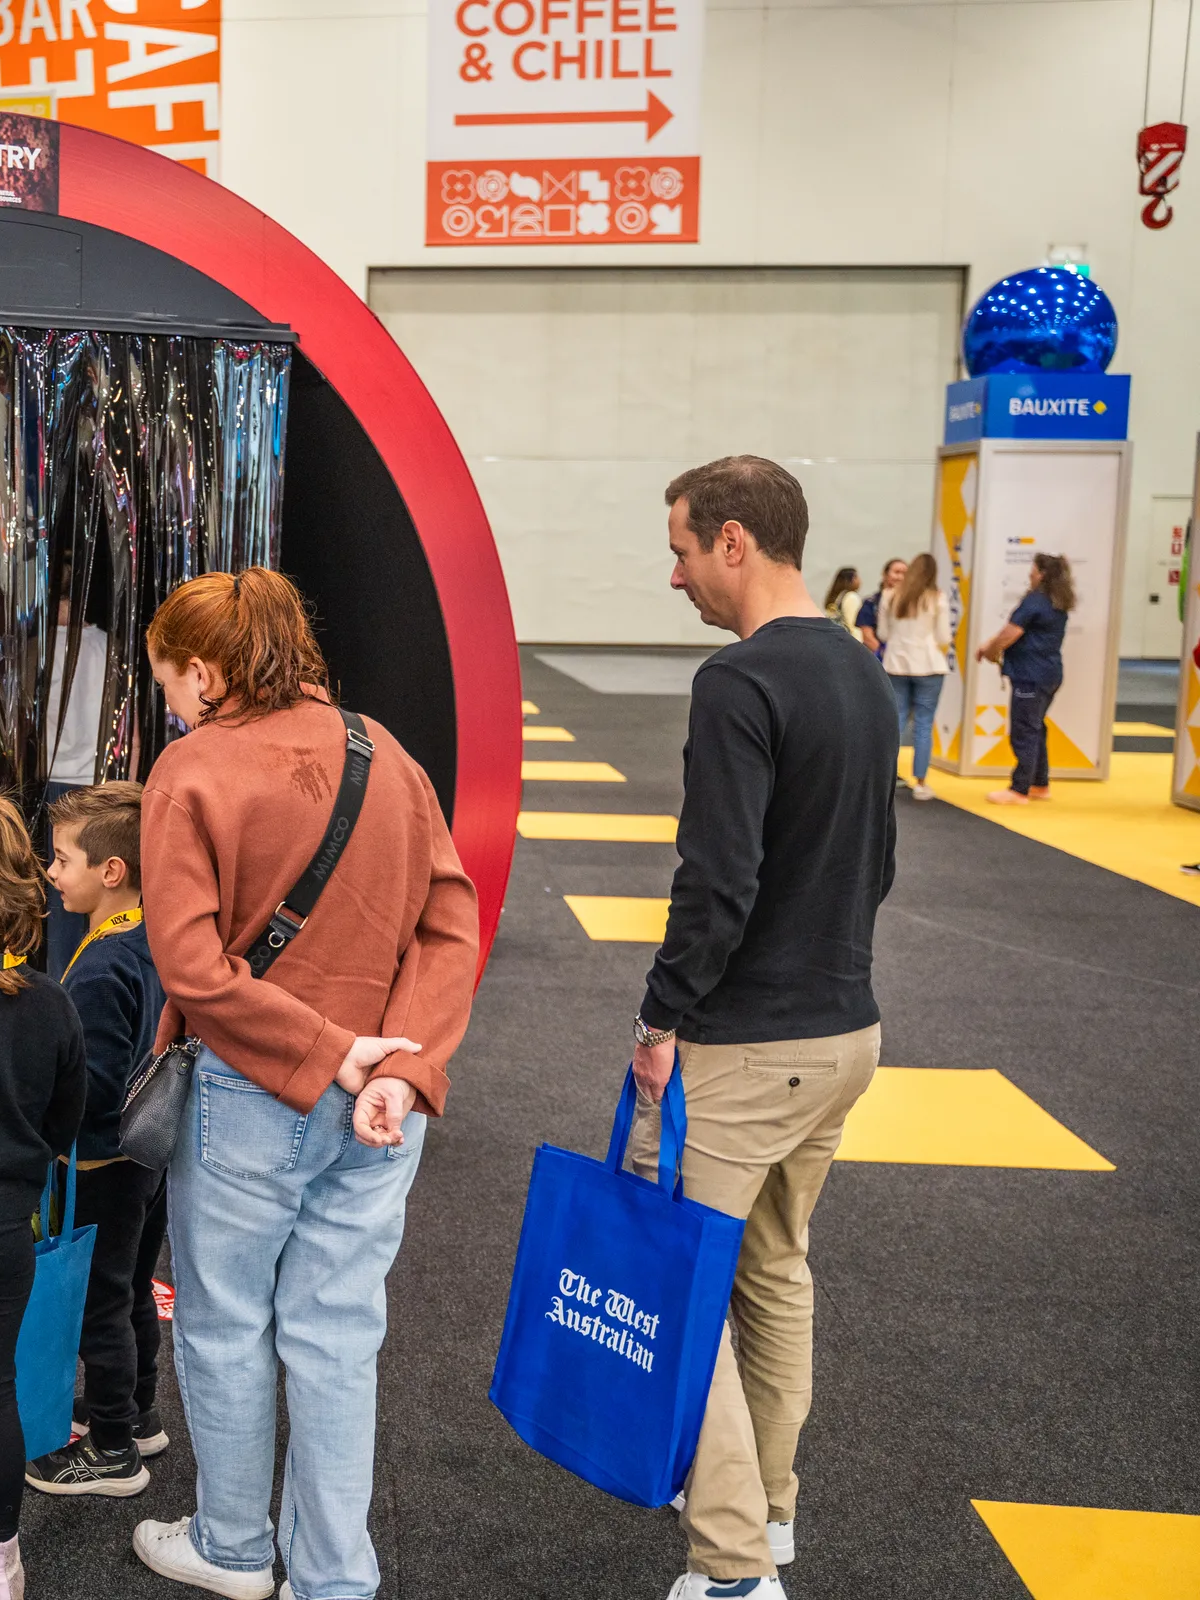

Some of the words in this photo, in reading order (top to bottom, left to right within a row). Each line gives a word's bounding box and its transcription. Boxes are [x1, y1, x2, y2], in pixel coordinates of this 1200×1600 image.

[455, 0, 678, 37] COFFEE
[458, 42, 494, 83] &
[511, 38, 673, 81] CHILL
[1008, 397, 1090, 417] BAUXITE
[312, 815, 350, 882] MIMCO
[558, 1268, 602, 1308] The
[604, 1288, 660, 1340] West
[544, 1296, 656, 1373] Australian
